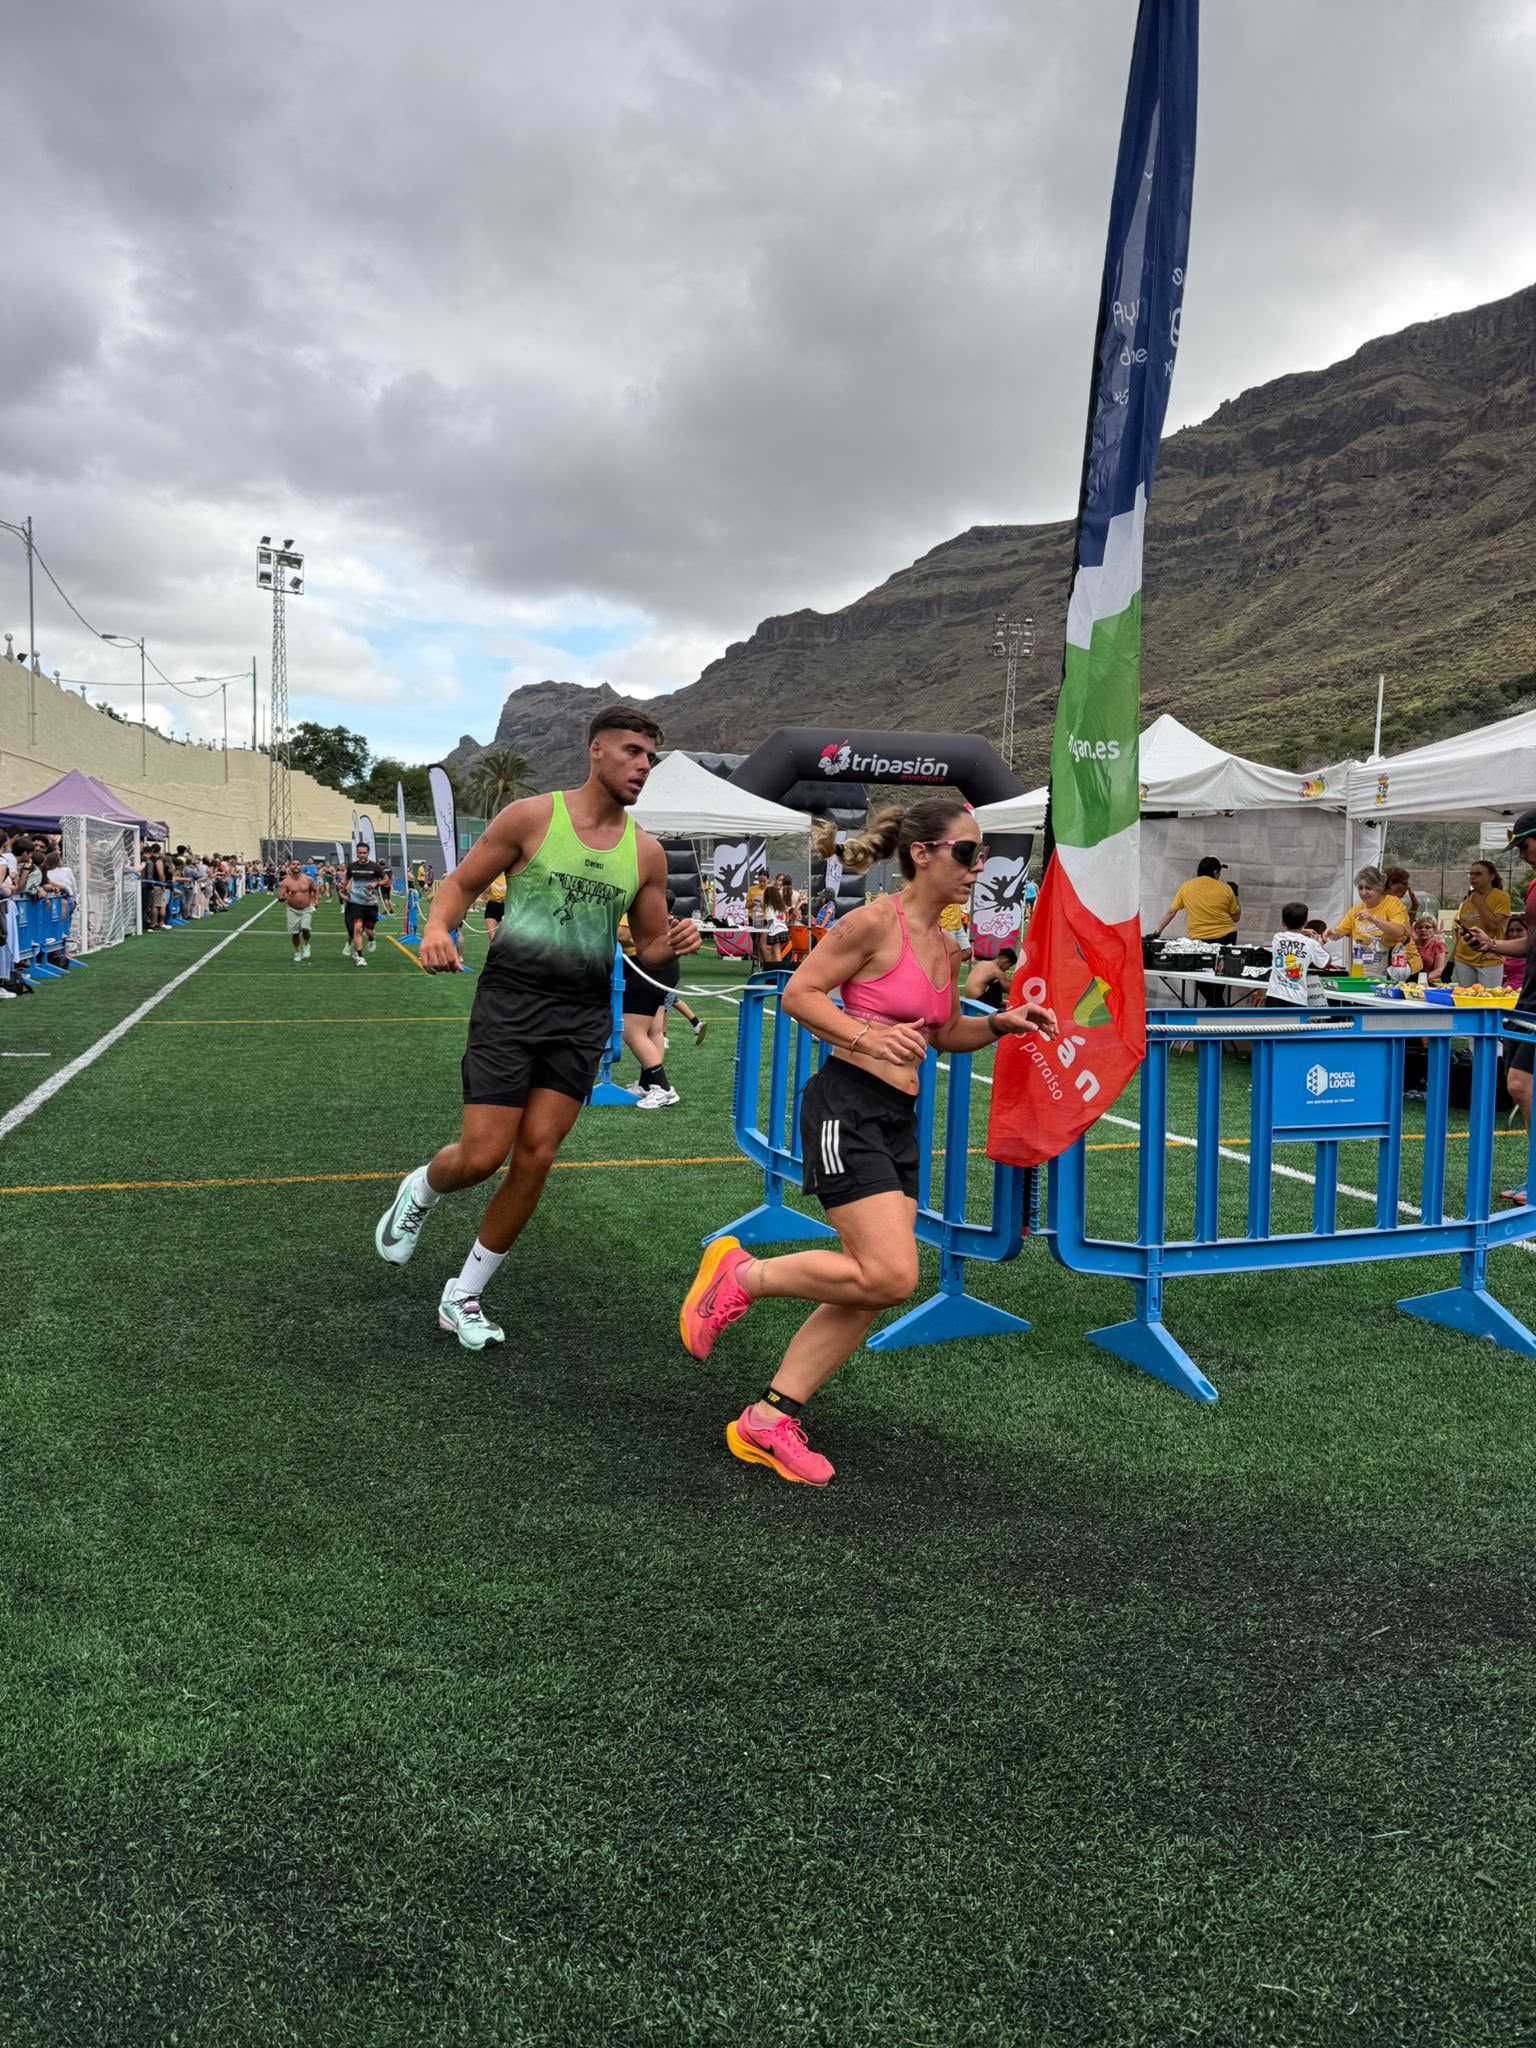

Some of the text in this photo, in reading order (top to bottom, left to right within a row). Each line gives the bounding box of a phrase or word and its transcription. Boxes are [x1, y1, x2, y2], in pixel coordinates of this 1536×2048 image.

[851, 753, 949, 777] tripasión
[1279, 940, 1306, 951] BART
[1277, 948, 1308, 959] RULES
[1329, 1079, 1355, 1088] LOCAL
